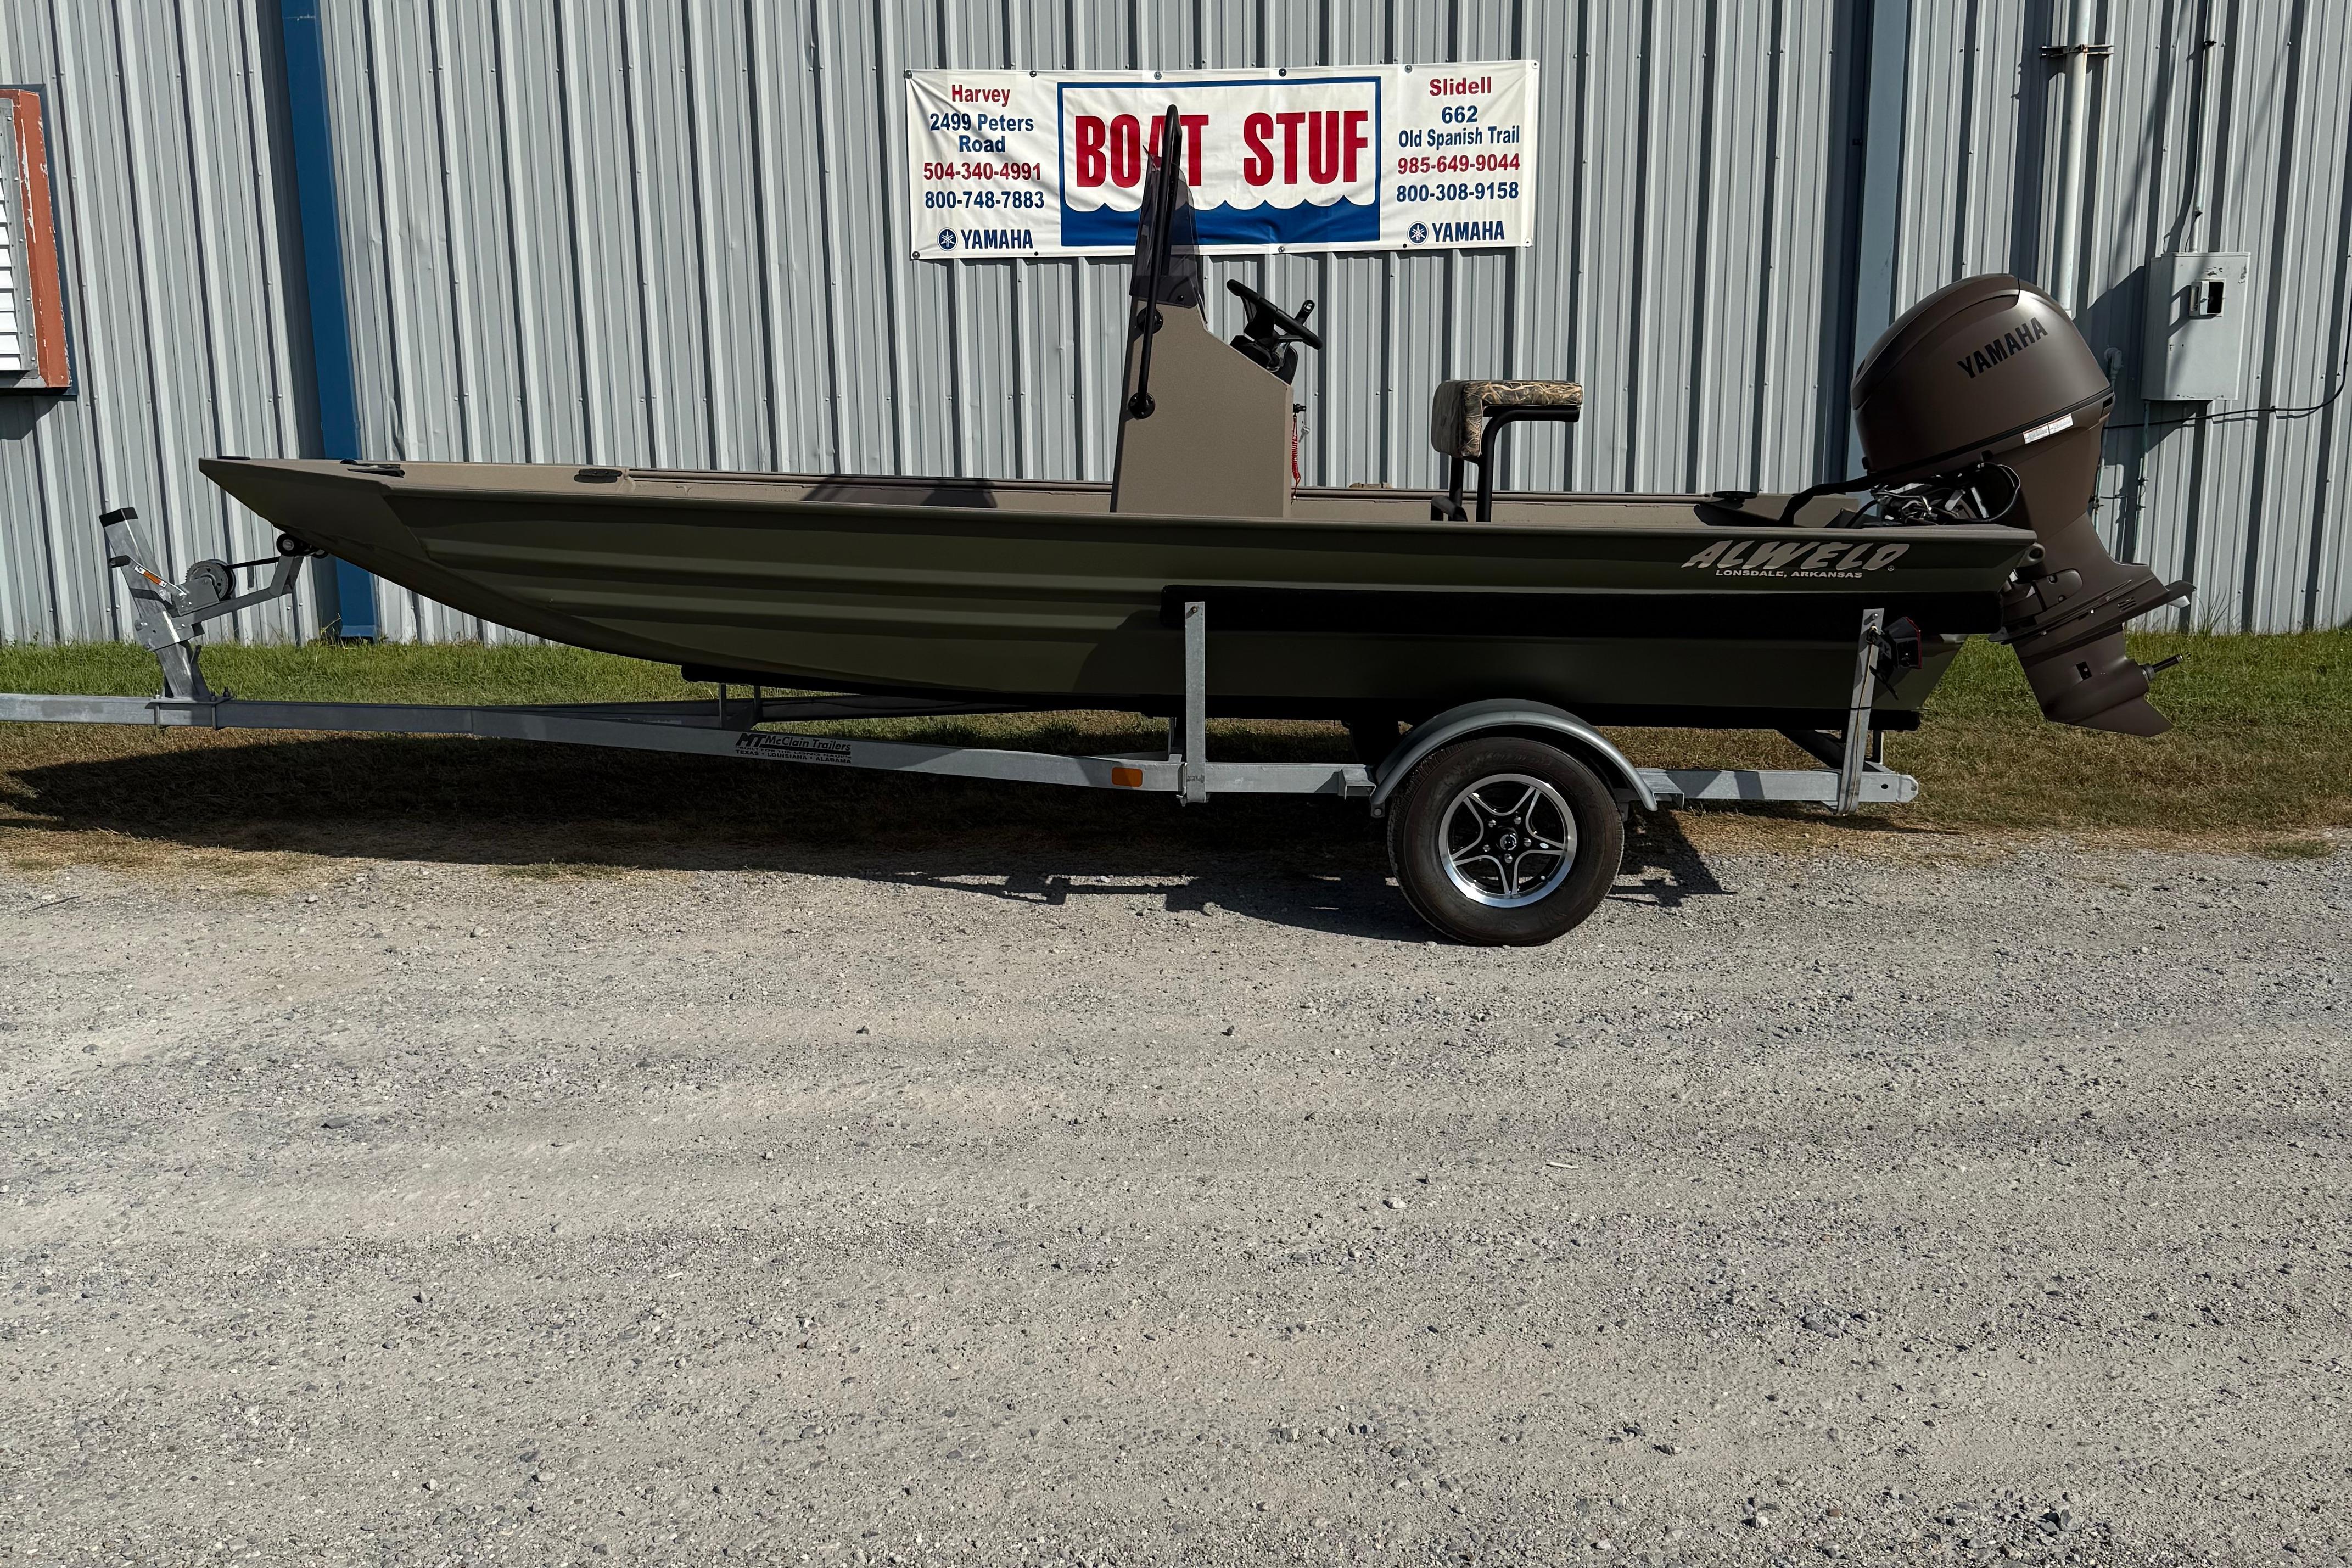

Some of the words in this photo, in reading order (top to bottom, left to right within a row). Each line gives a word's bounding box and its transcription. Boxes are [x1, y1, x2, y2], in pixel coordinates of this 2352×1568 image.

[951, 84, 1010, 107] Harvey
[1429, 76, 1492, 97] Slidell
[929, 113, 972, 131] 2499
[977, 114, 1034, 132] Peters
[1441, 105, 1478, 124] 662
[959, 135, 1006, 153] Road
[1398, 128, 1423, 148] Old
[1427, 126, 1483, 150] Spanish
[1487, 125, 1520, 144] Trail
[1243, 110, 1368, 187] STUF
[923, 161, 1041, 180] 504-340-4991
[1397, 153, 1520, 175] 985-649-9044
[925, 191, 1044, 209] 800-748-7883
[1396, 181, 1519, 203] 800-308-9158
[961, 229, 1033, 249] YAMAHA
[1432, 220, 1505, 242] YAMAHA
[1957, 317, 2048, 379] YAMAHA
[1681, 540, 1910, 570] ALWELD
[1716, 569, 1788, 578] LONSDALE,
[765, 735, 809, 748] McClain
[813, 738, 851, 751] Trailers
